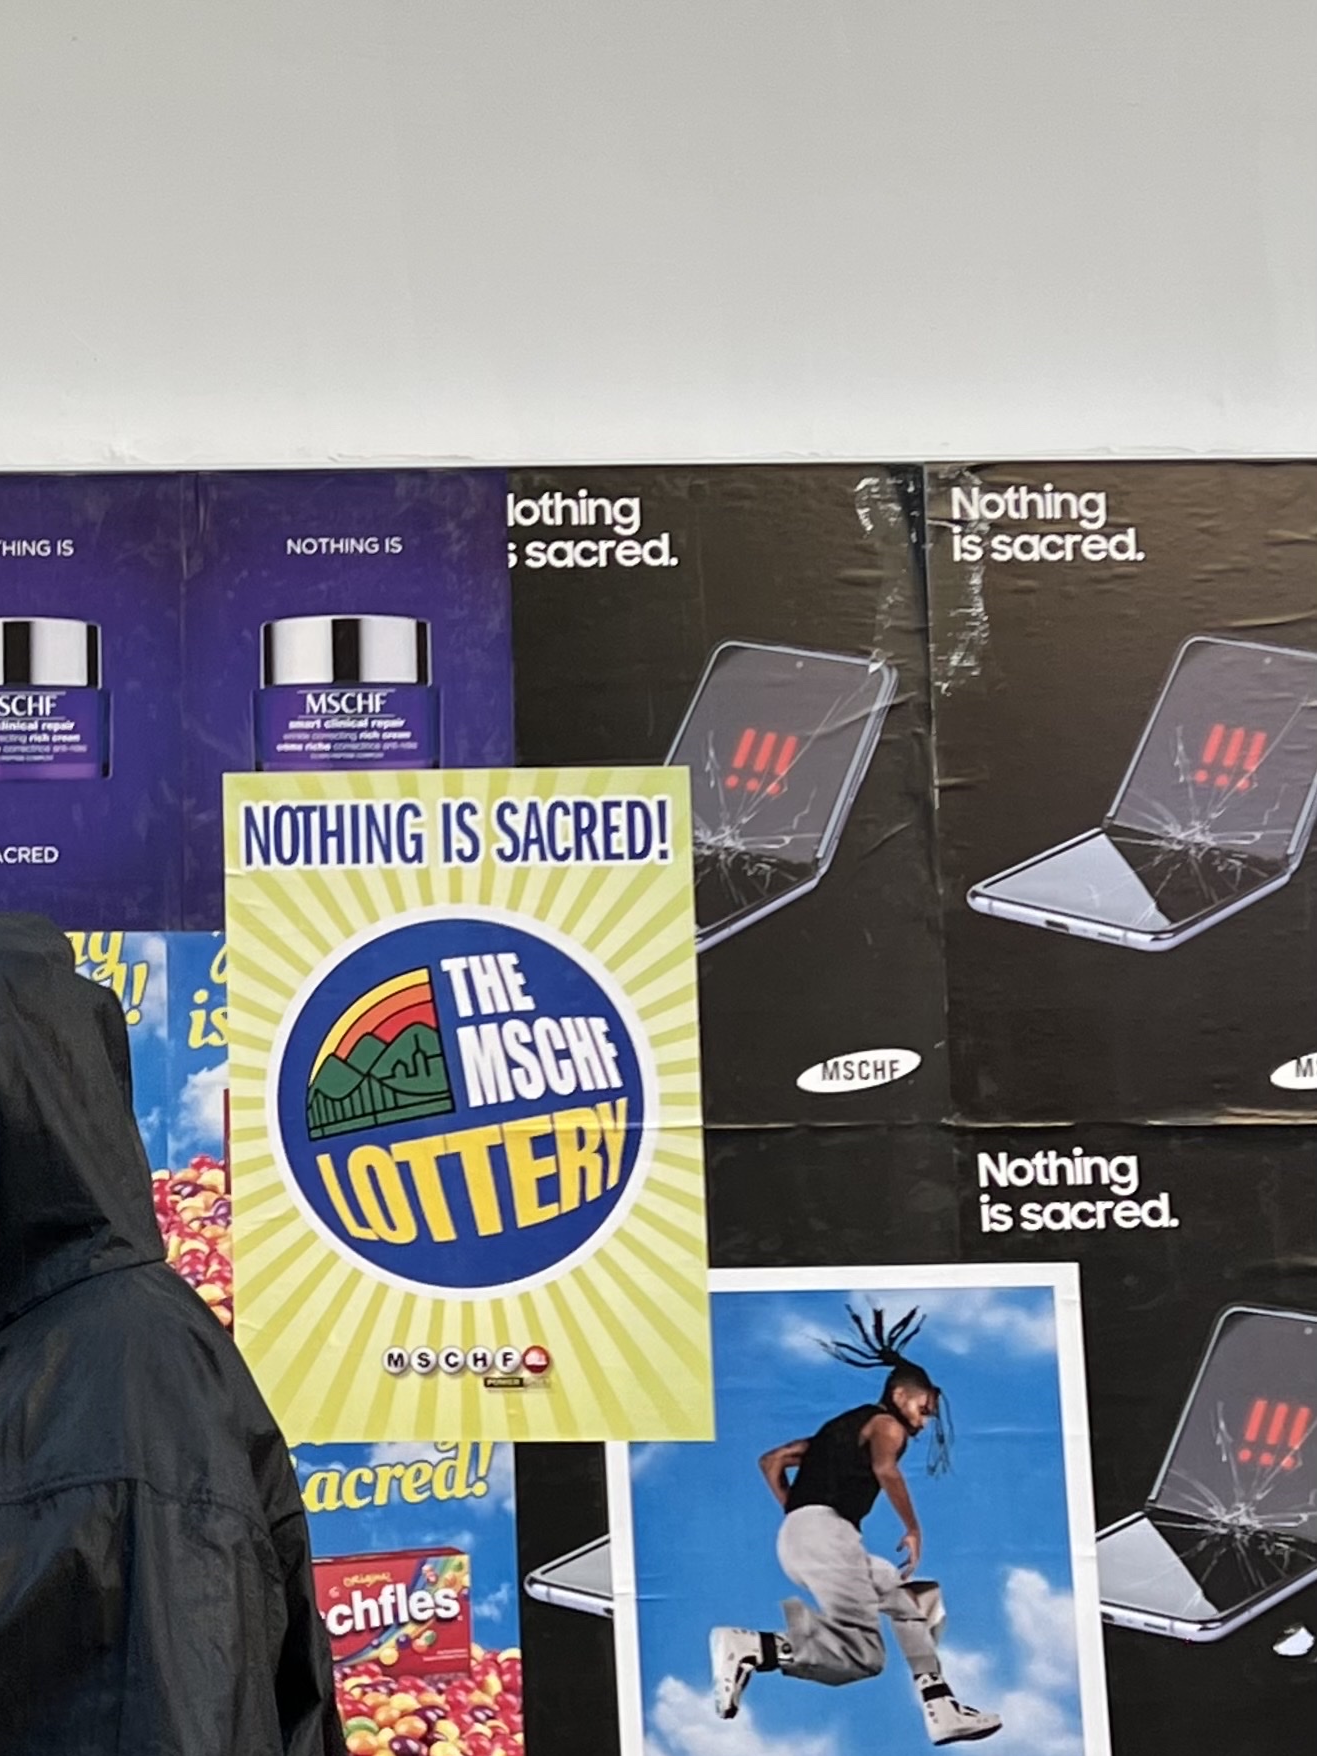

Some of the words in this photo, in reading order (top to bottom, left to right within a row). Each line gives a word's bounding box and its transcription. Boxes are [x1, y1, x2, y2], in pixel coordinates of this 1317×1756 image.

[950, 483, 1107, 530] Nothing
[56, 539, 74, 556] IS
[286, 537, 379, 555] NOTHING
[384, 536, 403, 554] IS
[525, 533, 679, 568] sacred.
[952, 527, 983, 562] is
[991, 528, 1145, 561] sacred.
[305, 692, 387, 714] MSCHF
[41, 721, 75, 732] repair
[288, 719, 321, 730] smart
[324, 718, 368, 729] clinical
[371, 718, 406, 729] repair
[243, 801, 423, 866] NOTHING
[442, 801, 480, 864] IS
[496, 800, 670, 862] SACRED!
[440, 951, 536, 1017] THE
[456, 1017, 624, 1108] MSCHF
[821, 1060, 902, 1081] MSCHF
[317, 1097, 628, 1245] LOTTERY
[977, 1147, 1139, 1196] Nothing
[980, 1194, 1013, 1232] is
[1021, 1192, 1179, 1230] sacred.
[300, 1441, 494, 1512] acred!
[325, 1582, 461, 1636] chfles
